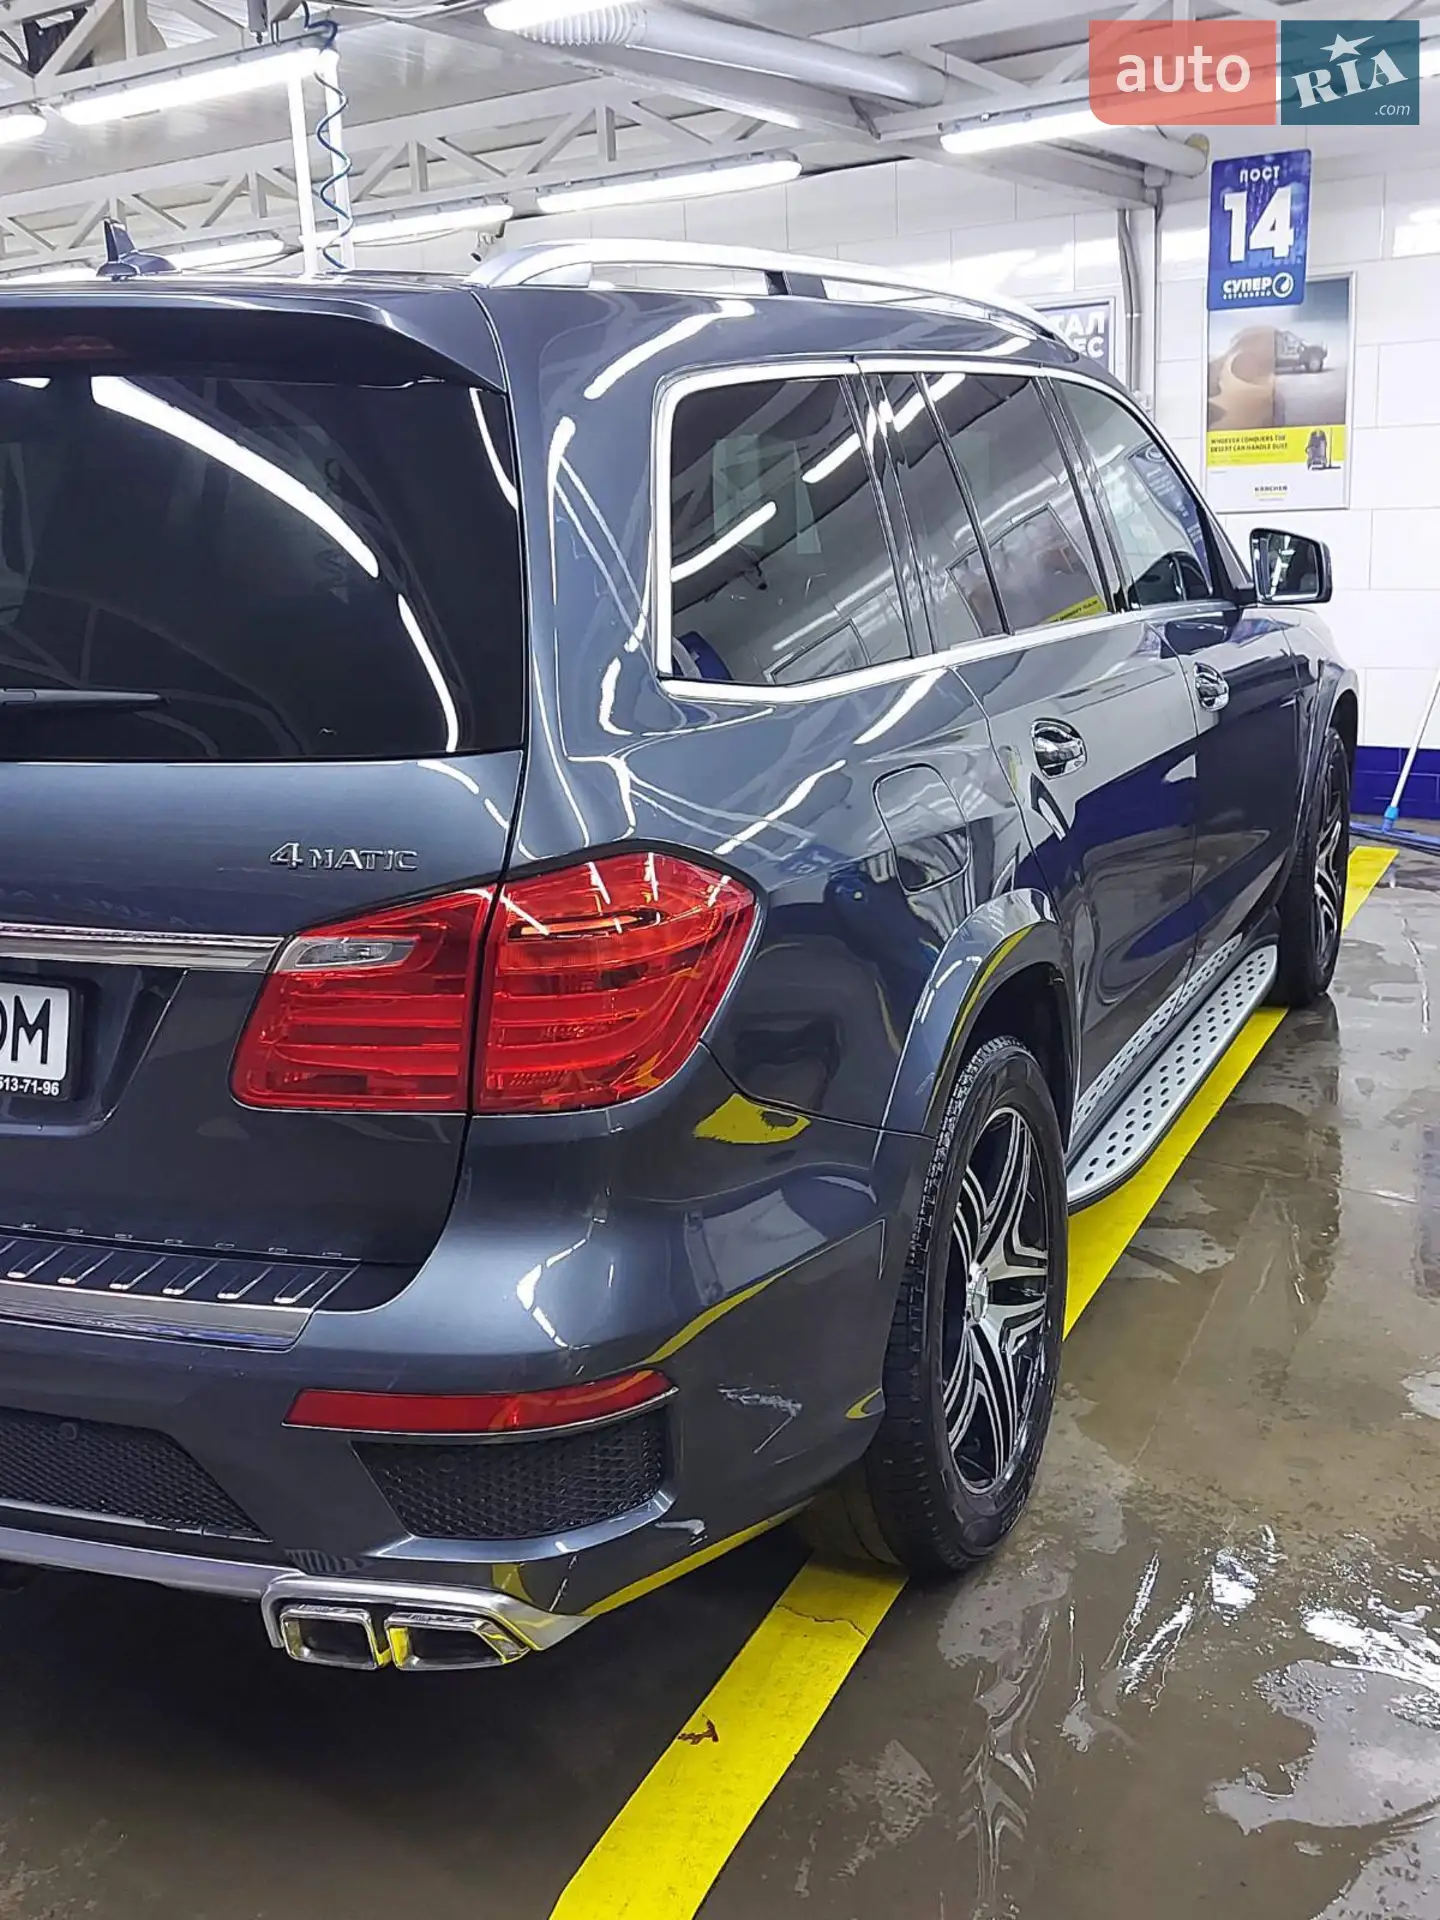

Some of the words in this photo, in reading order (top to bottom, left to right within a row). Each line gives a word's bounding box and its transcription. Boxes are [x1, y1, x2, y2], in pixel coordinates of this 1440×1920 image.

[1224, 186, 1294, 262] 14
[1223, 276, 1272, 294] СУПЕР
[0, 994, 51, 1065] M
